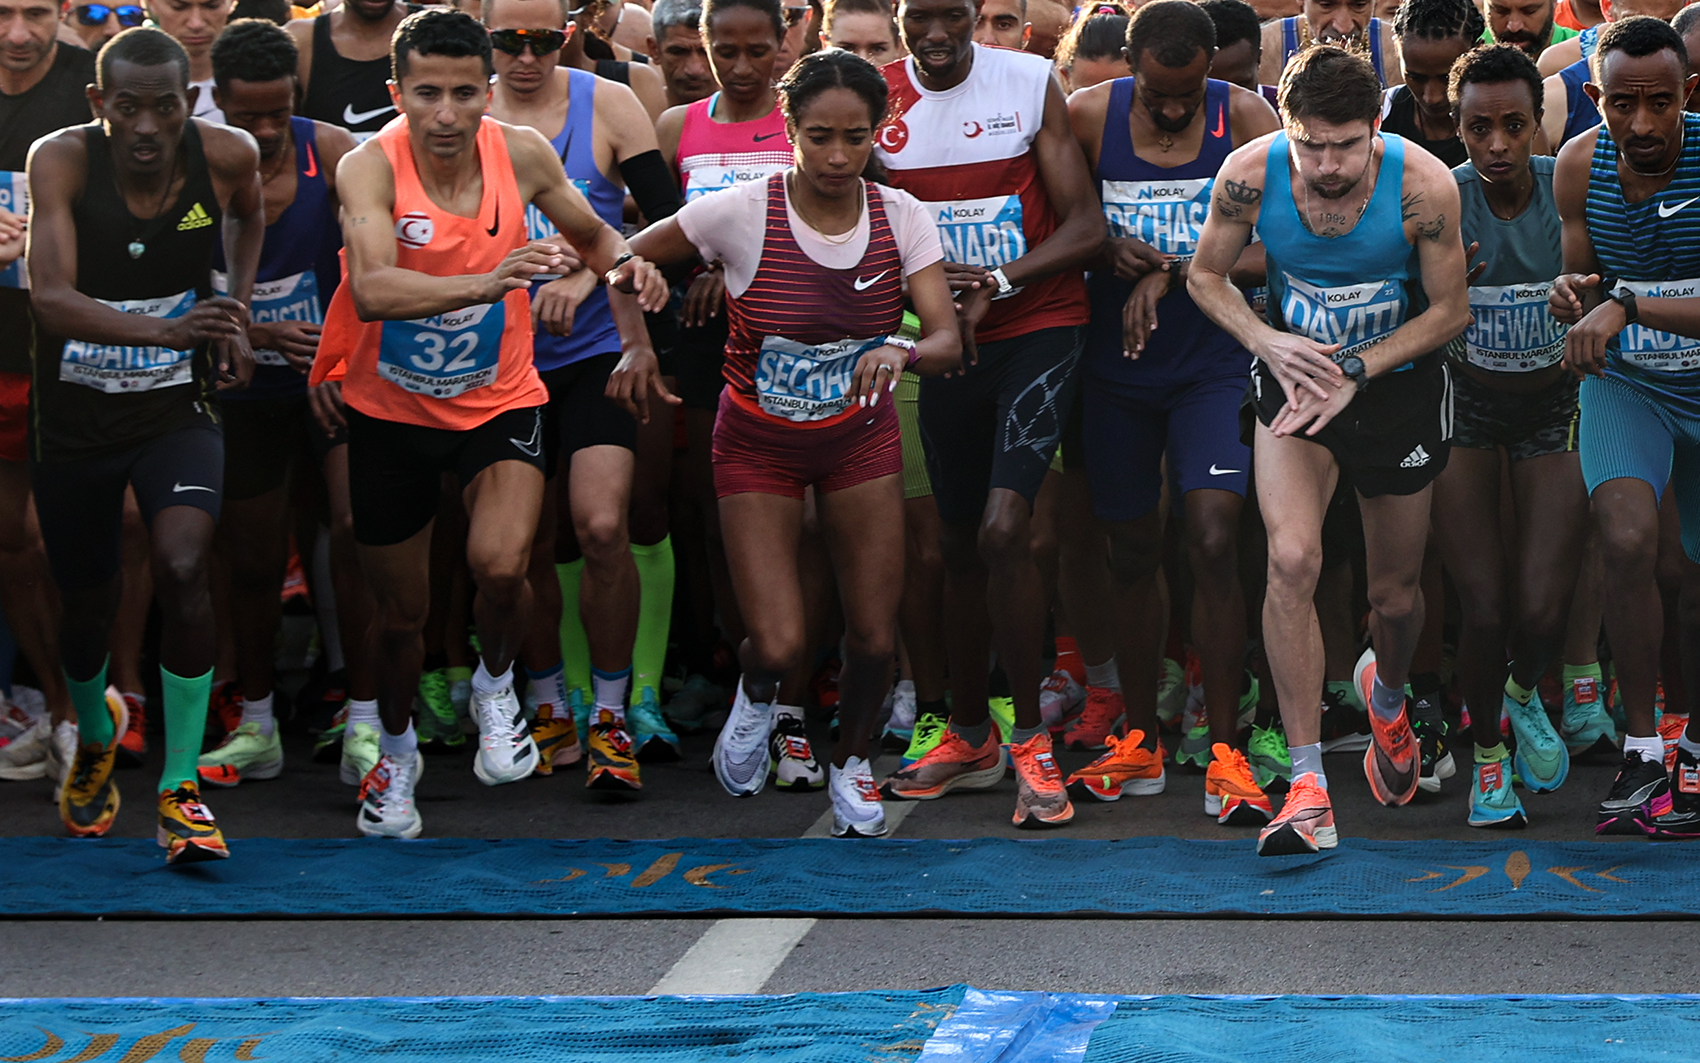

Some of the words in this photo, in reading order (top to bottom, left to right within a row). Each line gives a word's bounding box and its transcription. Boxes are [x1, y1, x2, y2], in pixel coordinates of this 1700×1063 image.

[1153, 188, 1186, 197] KOLAY
[953, 208, 986, 218] KOLAY
[1319, 213, 1347, 225] 1992
[1327, 291, 1362, 303] KOLAY
[1385, 288, 1394, 296] 22
[1515, 288, 1548, 299] KOLAY
[1661, 287, 1695, 298] KOLAY
[442, 313, 475, 327] KOLAY
[410, 331, 479, 373] 32
[1475, 348, 1521, 360] ISTANBUL
[1634, 353, 1680, 361] ISTANBUL
[388, 366, 436, 386] ISTANBUL
[435, 368, 492, 386] MARATHON
[763, 395, 811, 411] ISTANBUL
